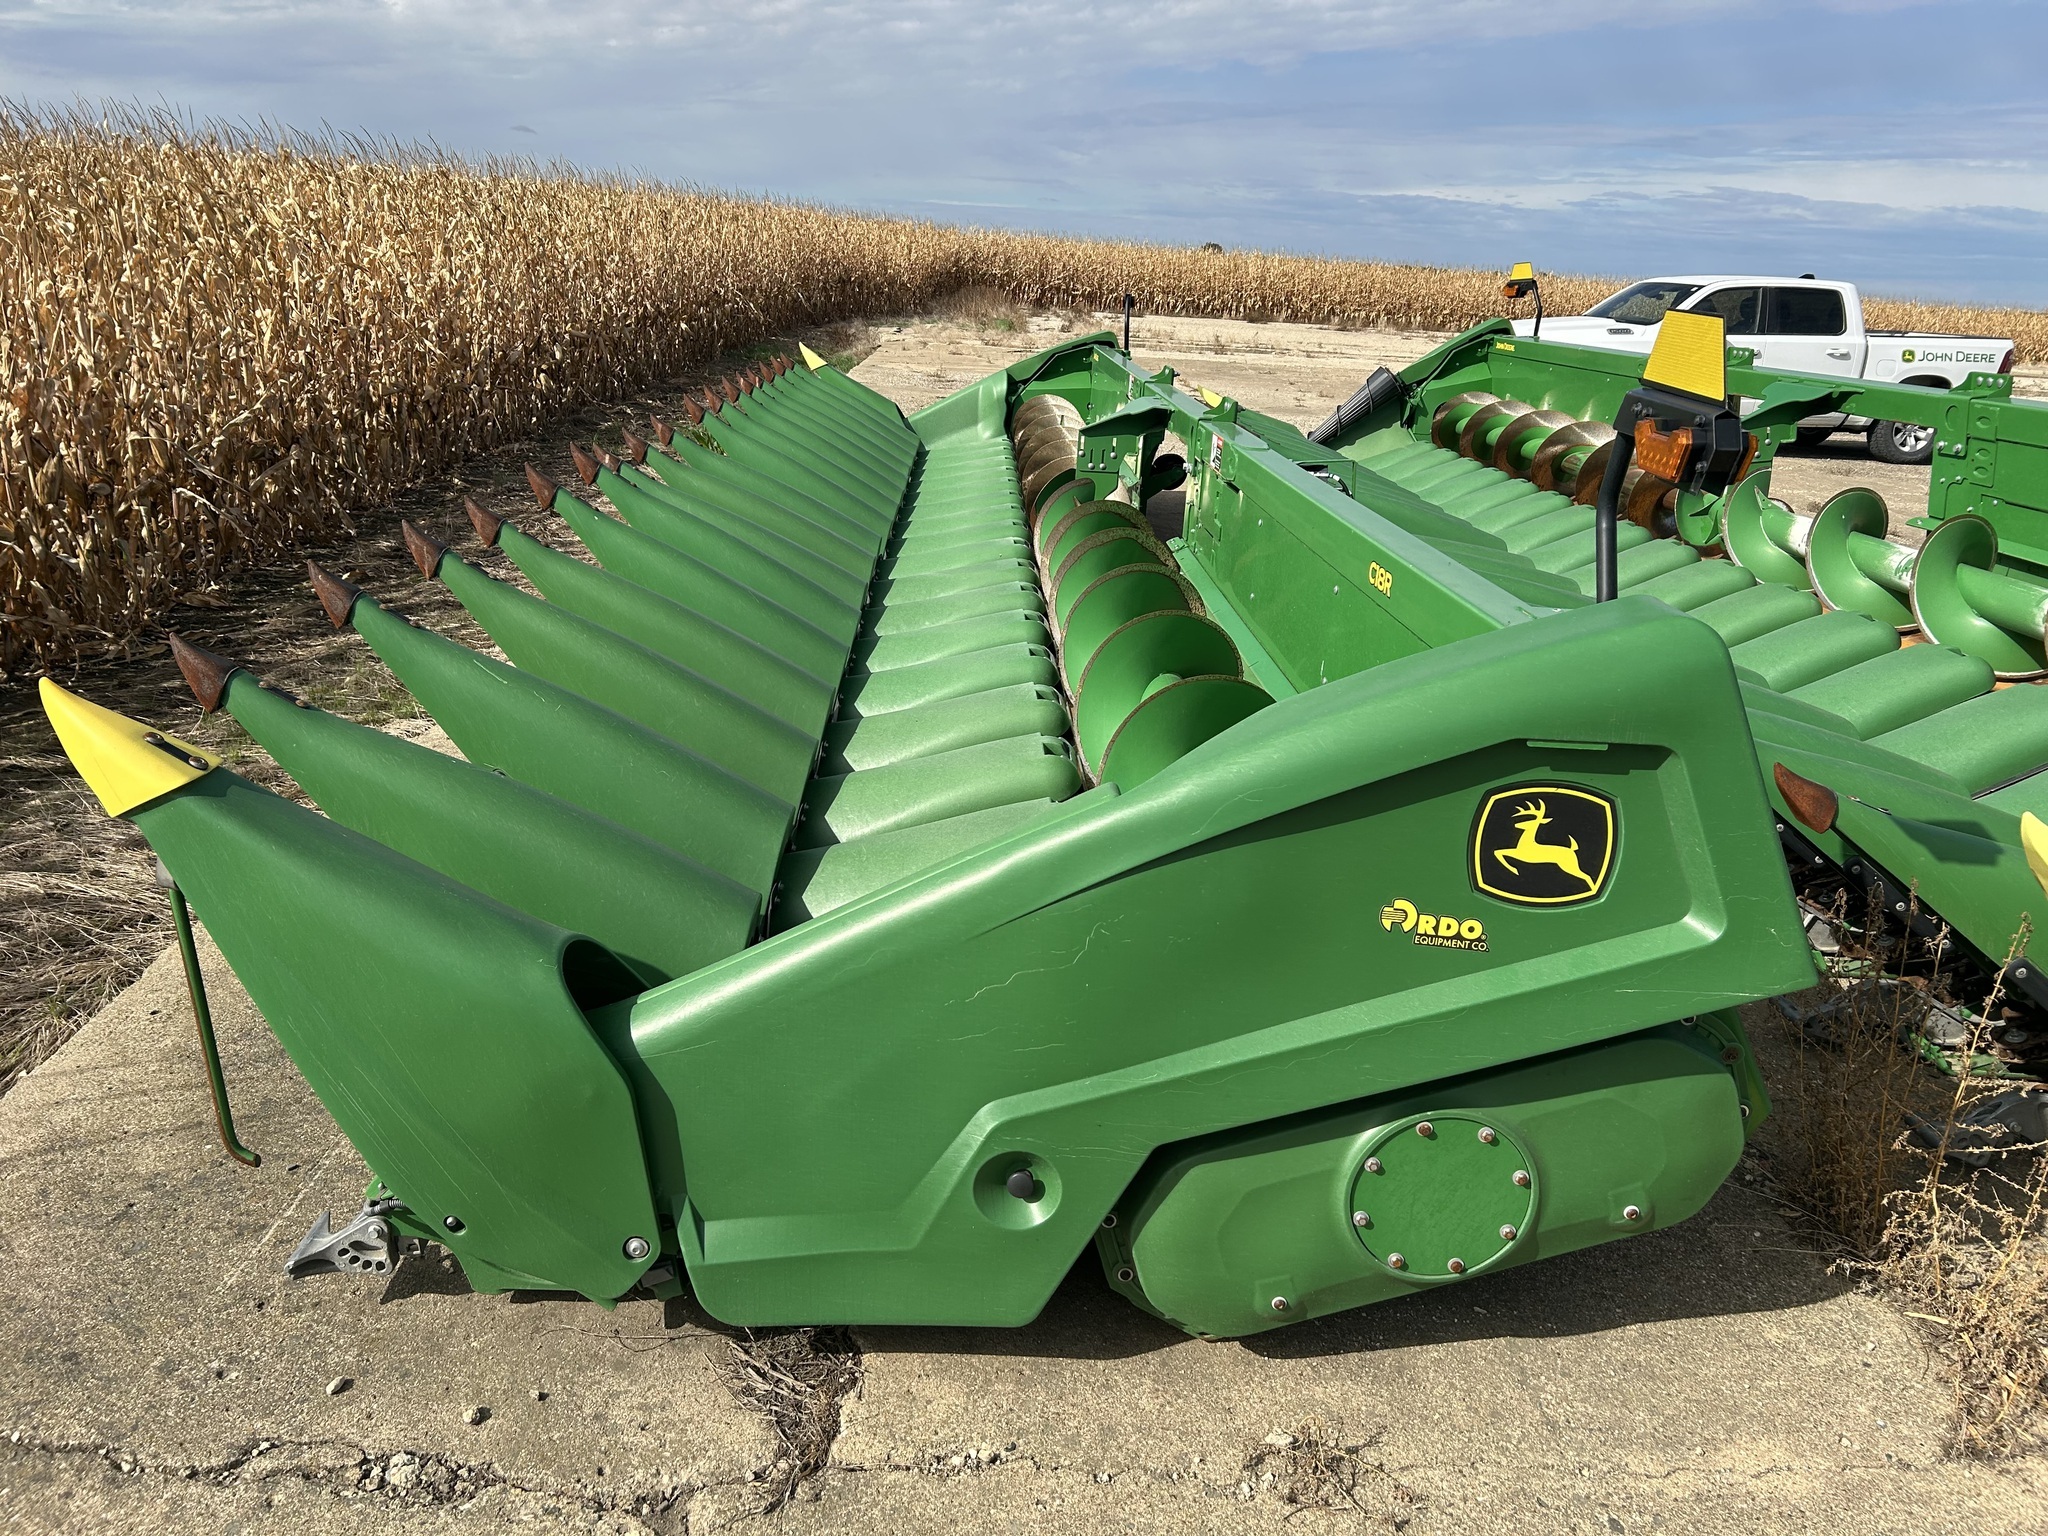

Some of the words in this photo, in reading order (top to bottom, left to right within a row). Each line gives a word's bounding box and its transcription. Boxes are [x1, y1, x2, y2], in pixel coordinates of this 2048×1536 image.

[1918, 350, 1953, 362] JOHN
[1956, 351, 1996, 363] DEERE
[1369, 560, 1393, 599] C18R
[1415, 935, 1470, 949] EQUIPMENT
[1472, 941, 1489, 951] CO.
